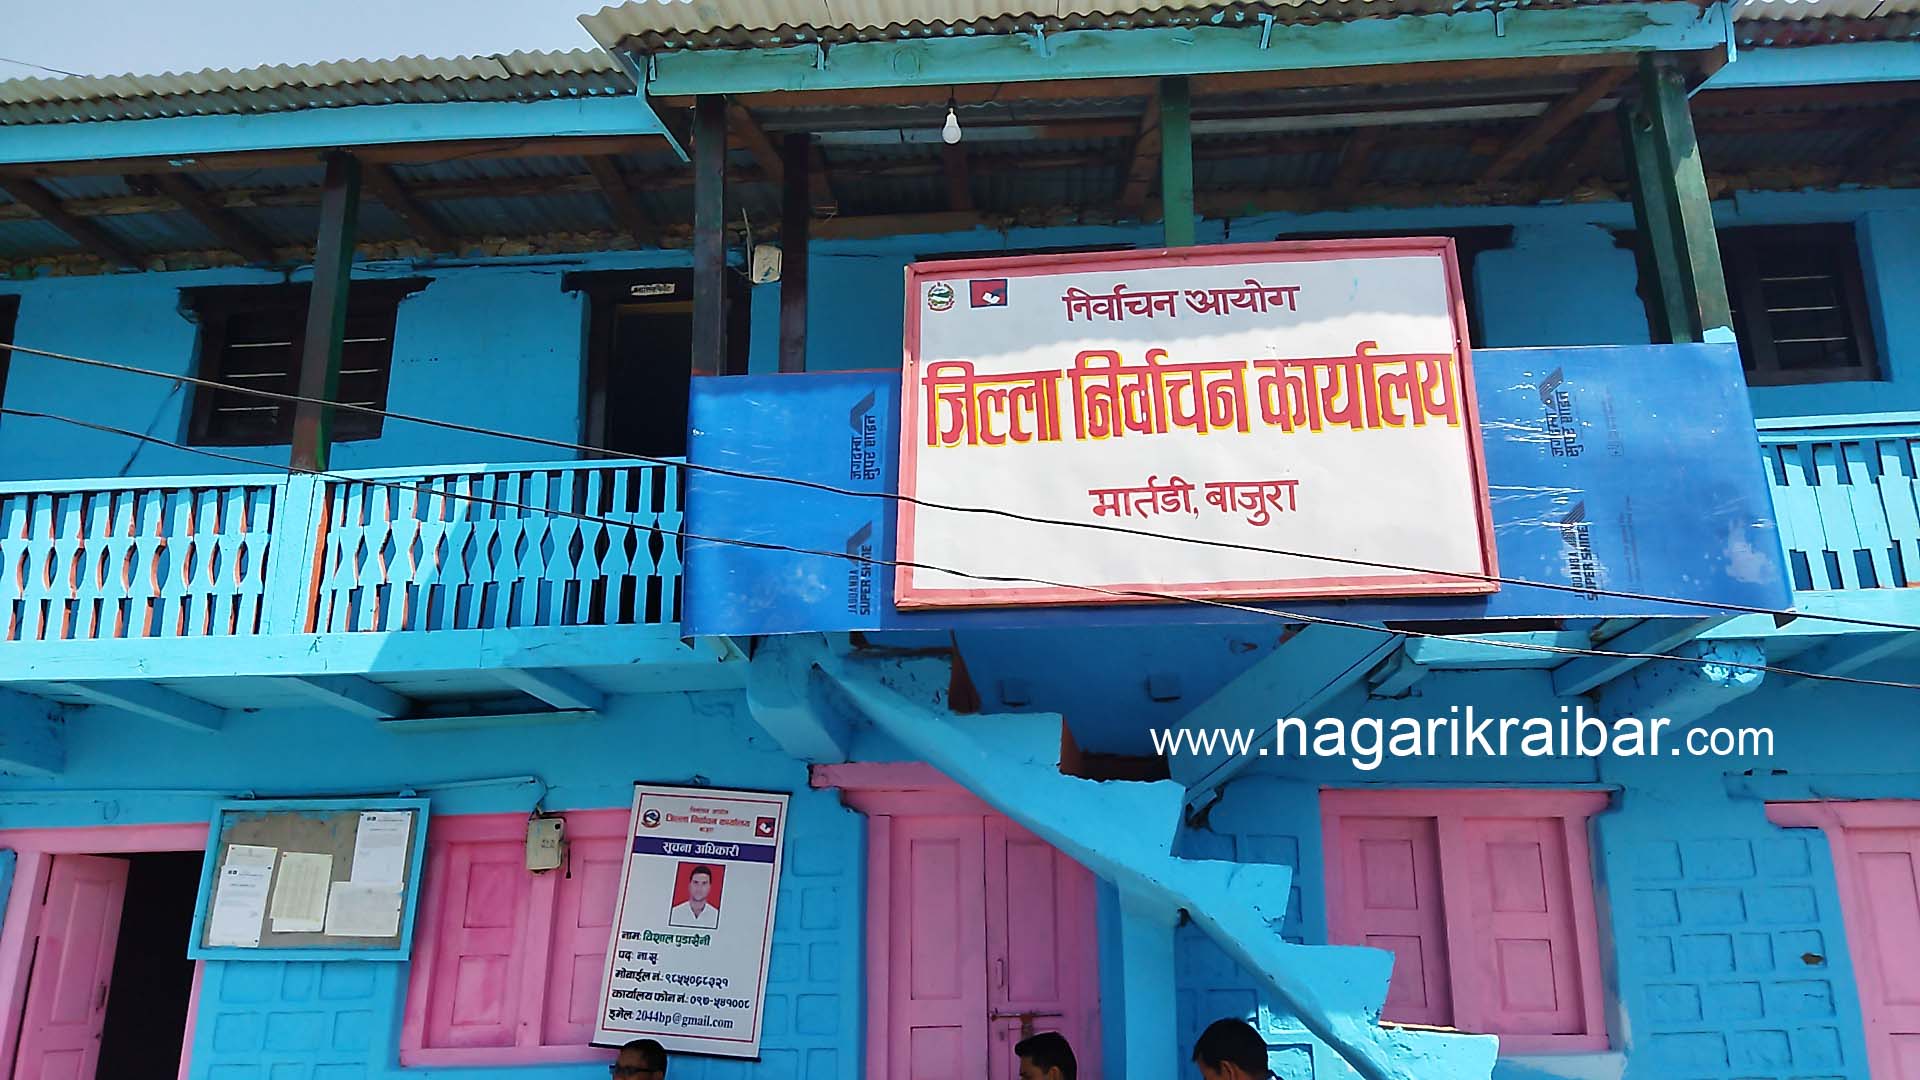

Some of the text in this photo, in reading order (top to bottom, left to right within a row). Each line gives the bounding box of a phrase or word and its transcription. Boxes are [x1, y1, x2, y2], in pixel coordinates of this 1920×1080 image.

[1061, 278, 1300, 322] निर्वाचन आयोग
[922, 340, 1460, 448] जिल्ला निर्वाचन कार्यालय
[863, 451, 881, 480] सुपर
[1205, 479, 1298, 526] बाजुरा
[860, 544, 872, 616] SUPER SHNE
[1568, 552, 1585, 600] JGDAMBA
[663, 841, 739, 857] सूचना अधिकारी
[636, 1009, 733, 1029] 2044bp@gmail.com
